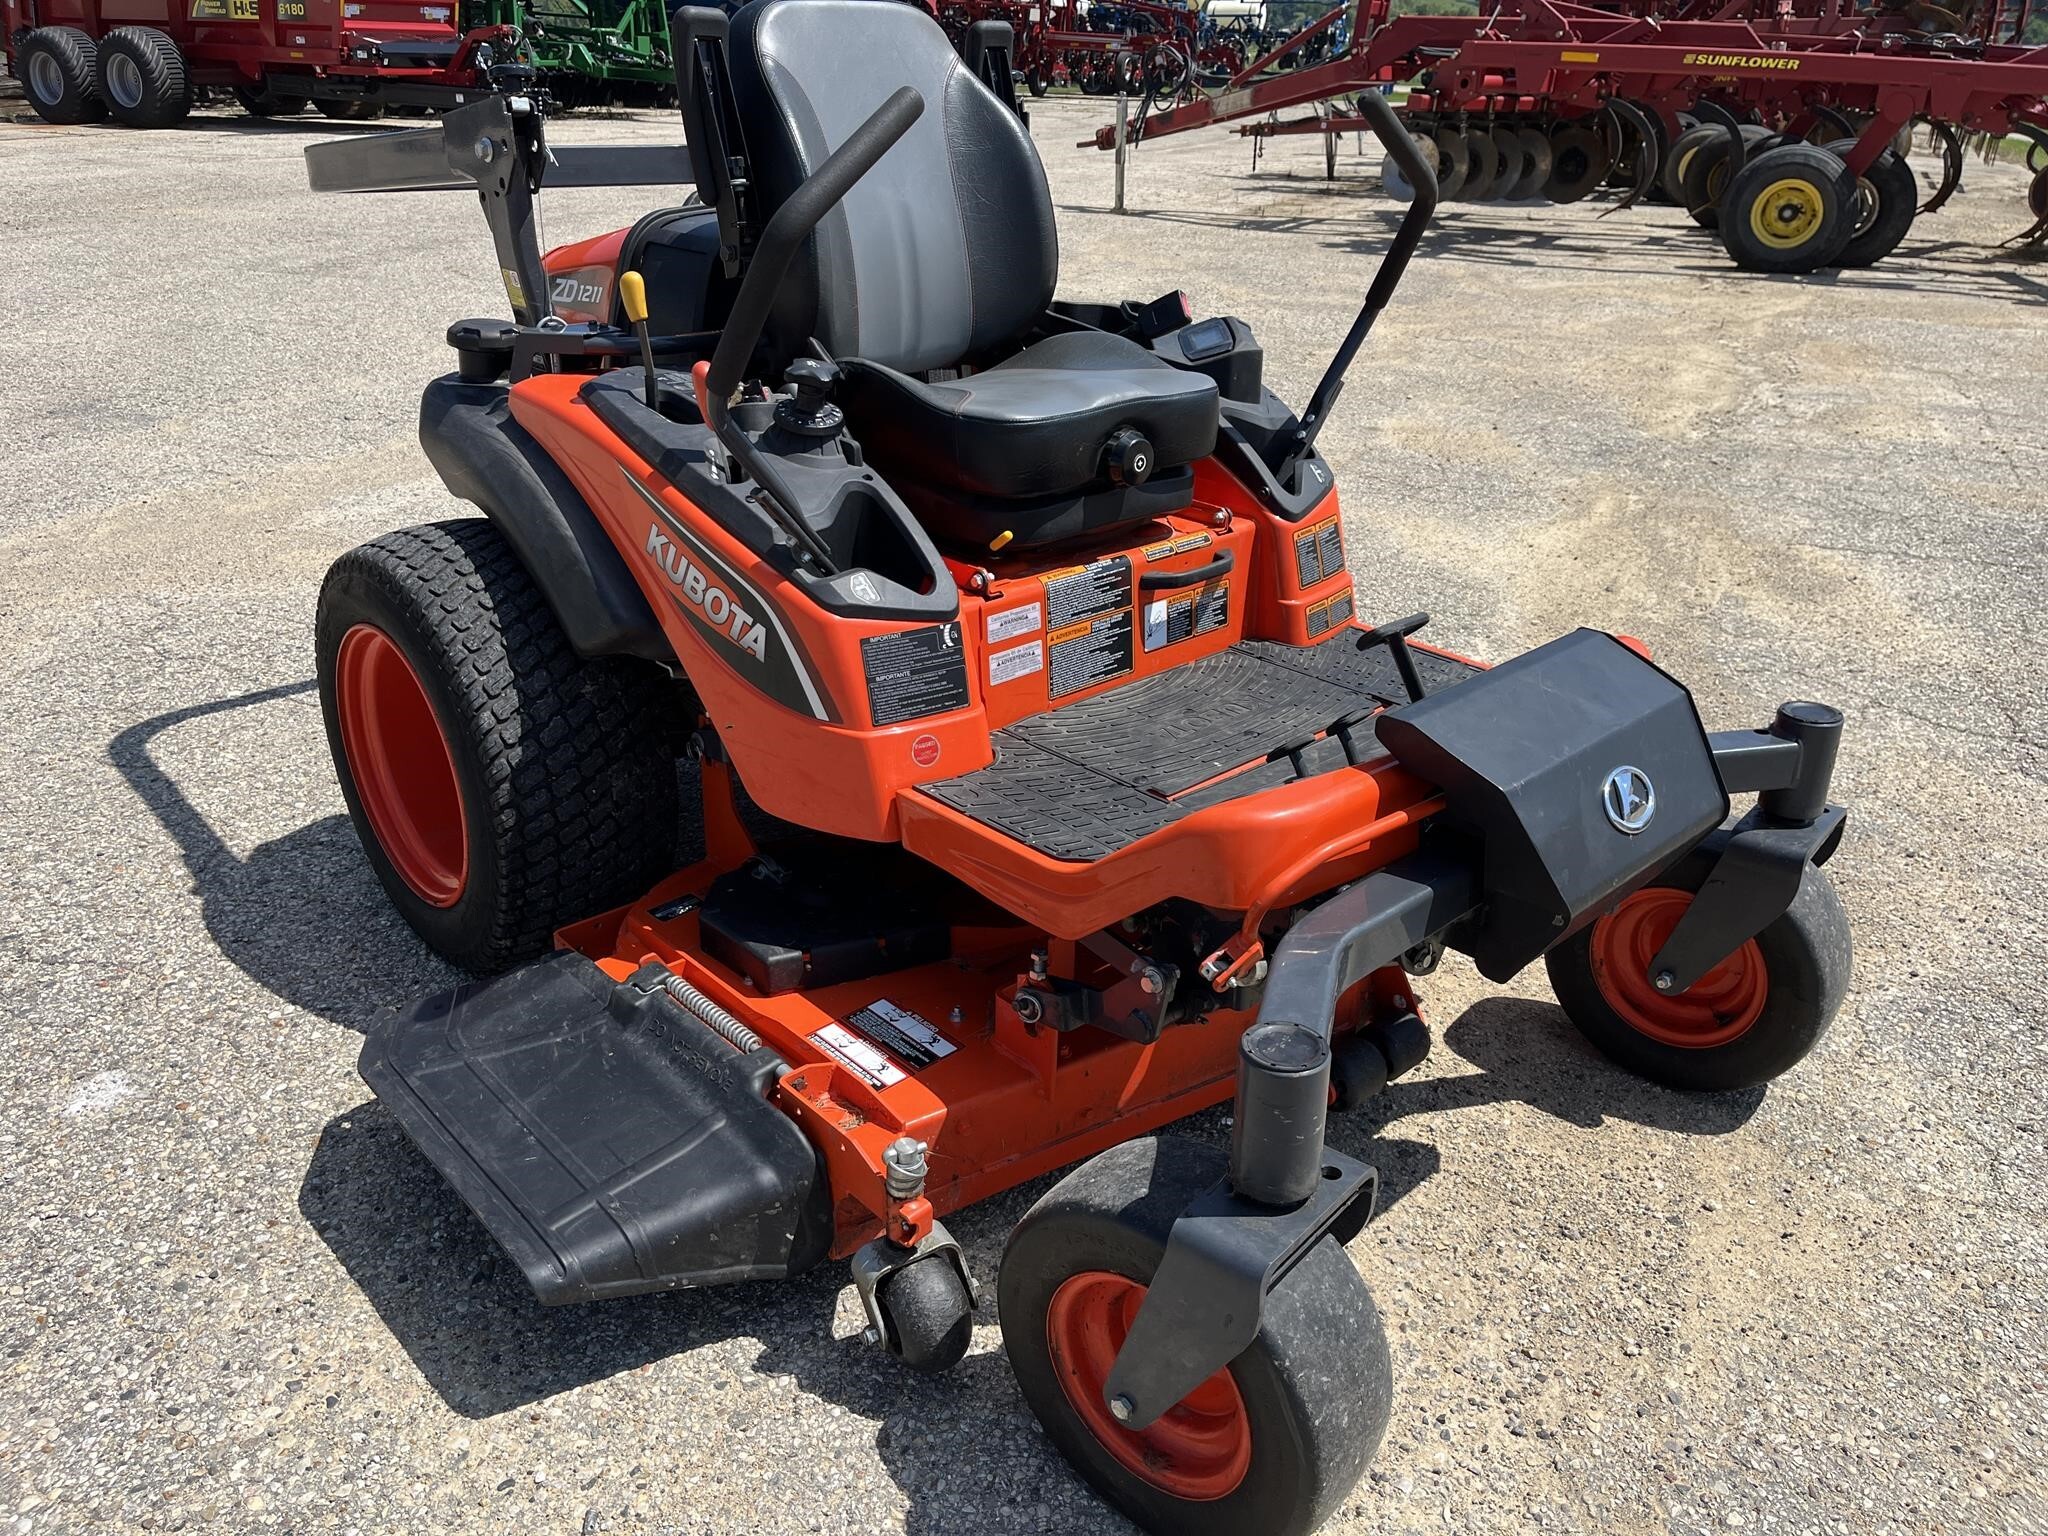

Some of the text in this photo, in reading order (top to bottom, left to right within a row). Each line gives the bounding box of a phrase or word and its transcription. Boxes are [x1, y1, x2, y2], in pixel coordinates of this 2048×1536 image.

[279, 3, 305, 15] 6180
[1695, 54, 1800, 70] SUNFLOWER
[551, 278, 579, 302] ZD
[579, 285, 603, 303] 1211
[646, 523, 766, 663] KUBOTA
[869, 633, 902, 643] IMPORTANT
[1056, 626, 1088, 639] ADVERTENCIA
[1001, 652, 1032, 665] ADVERTENCIA
[876, 671, 911, 681] IMPORTANTE
[913, 1013, 939, 1033] PELIGRO
[865, 1039, 889, 1059] DANGER
